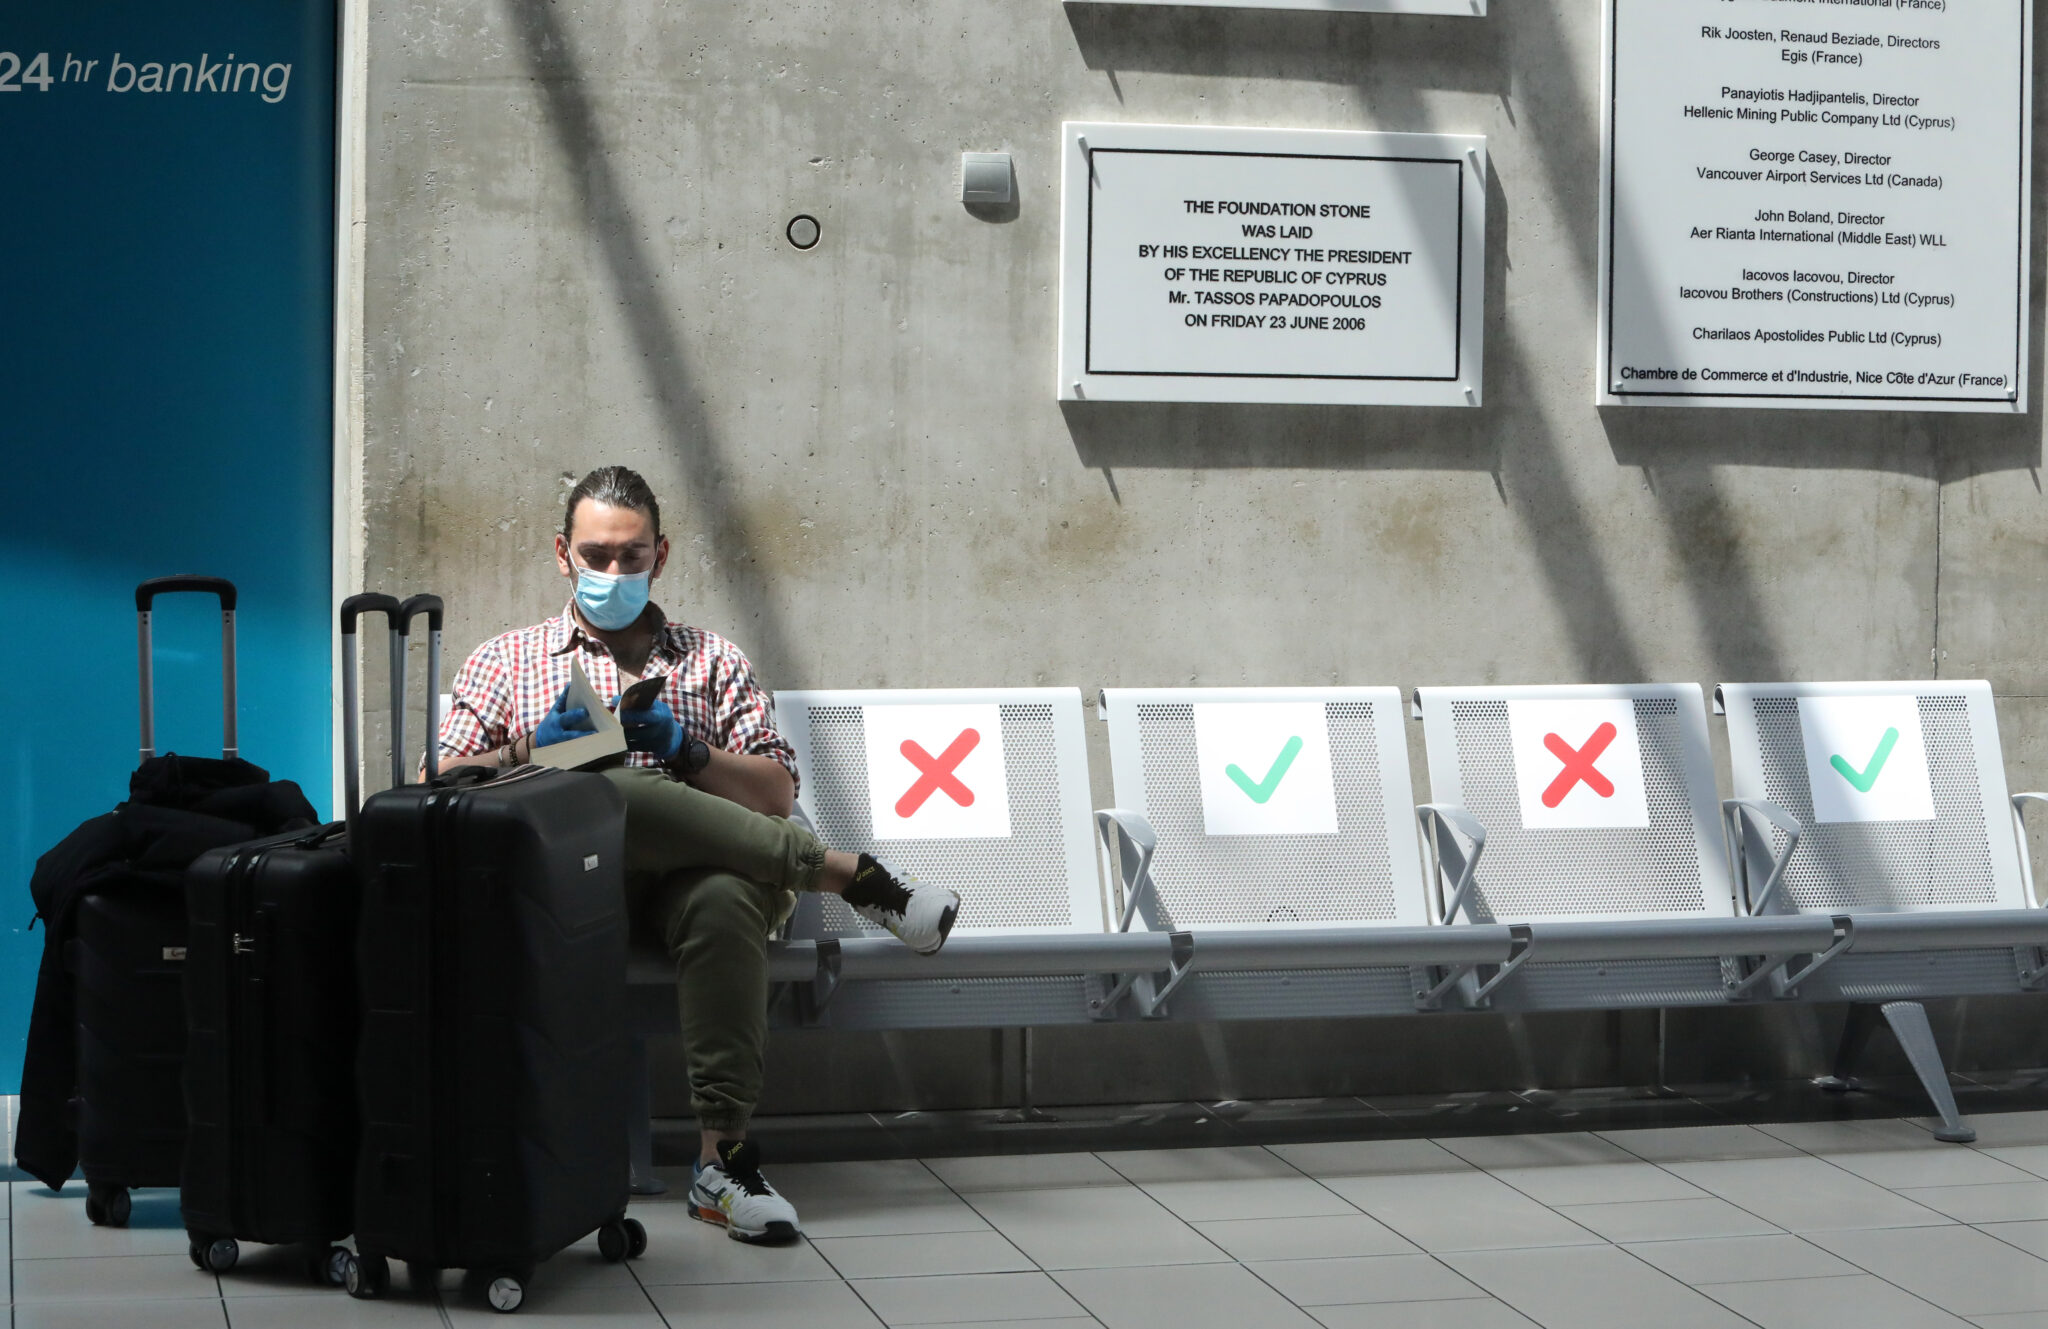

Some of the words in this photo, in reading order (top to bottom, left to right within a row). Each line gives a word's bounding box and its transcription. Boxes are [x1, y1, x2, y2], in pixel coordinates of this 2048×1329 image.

[1896, 0, 1946, 13] (France)
[1702, 27, 1722, 38] Rik
[1725, 28, 1776, 43] Joosten,
[1781, 30, 1828, 44] Renaud
[1832, 32, 1883, 48] Beziade,
[1888, 35, 1940, 49] Directors
[1782, 49, 1808, 64] Egis
[1812, 50, 1862, 67] (France)
[0, 52, 54, 91] 24
[61, 53, 98, 82] hr
[107, 53, 292, 103] banking
[1722, 86, 1784, 103] Panayiotis
[1788, 90, 1868, 106] Hadjipantelis,
[1873, 93, 1919, 106] Director
[1684, 106, 1733, 119] Hellenic
[1736, 108, 1777, 124] Mining
[1781, 109, 1818, 122] Public
[1822, 111, 1879, 128] Company
[1882, 114, 1900, 126] Ltd
[1904, 115, 1955, 131] (Cyprus)
[1750, 148, 1794, 164] George
[1798, 150, 1840, 166] Casey,
[1844, 152, 1891, 166] Director
[1696, 167, 1763, 181] Vancouver
[1766, 170, 1806, 184] Airport
[1810, 171, 1861, 184] Services
[1865, 173, 1883, 185] Ltd
[1888, 174, 1942, 190] (Canada)
[1184, 200, 1214, 214] THE
[1218, 201, 1316, 216] FOUNDATION
[1320, 204, 1370, 218] STONE
[1754, 209, 1784, 222] John
[1788, 210, 1833, 225] Boland,
[1838, 212, 1885, 225] Director
[1242, 224, 1276, 238] WAS
[1280, 226, 1313, 239] LAID
[1690, 226, 1712, 239] Aer
[1716, 227, 1755, 240] Rianta
[1760, 228, 1834, 242] International
[1838, 231, 1881, 245] (Middle
[1886, 233, 1916, 248] East)
[1920, 234, 1946, 246] WLL
[1139, 244, 1160, 258] BY
[1163, 245, 1188, 258] HIS
[1192, 246, 1291, 261] EXCELLENCY
[1294, 248, 1324, 262] THE
[1328, 250, 1412, 264] PRESIDENT
[1164, 268, 1186, 281] OF
[1189, 268, 1220, 282] THE
[1224, 269, 1298, 284] REPUBLIC
[1301, 271, 1322, 284] OF
[1326, 272, 1387, 286] CYPRUS
[1743, 268, 1789, 282] Iacovos
[1794, 270, 1843, 284] Iacovou,
[1848, 272, 1895, 284] Director
[1169, 290, 1190, 304] Mr.
[1194, 291, 1255, 306] TASSOS
[1259, 293, 1381, 308] PAPADOPOULOS
[1680, 286, 1728, 300] Iacovou
[1732, 288, 1783, 300] Brothers
[1787, 289, 1878, 306] (Constructions)
[1882, 292, 1900, 304] Ltd
[1904, 292, 1954, 308] (Cyprus)
[1185, 314, 1207, 327] ON
[1212, 314, 1266, 328] FRIDAY
[1270, 316, 1286, 328] 23
[1290, 316, 1329, 330] JUNE
[1332, 317, 1366, 330] 2006
[1693, 327, 1751, 340] Charilaos
[1754, 329, 1824, 343] Apostolides
[1828, 330, 1865, 343] Public
[1868, 332, 1887, 344] Ltd
[1891, 332, 1941, 348] (Cyprus)
[1622, 366, 1678, 380] Chambre
[1682, 368, 1697, 380] de
[1701, 368, 1768, 382] Commerce
[1772, 370, 1784, 382] et
[1786, 370, 1852, 384] d'Industrie,
[1856, 371, 1883, 384] Nice
[1886, 372, 1914, 384] Côte
[1918, 373, 1955, 385] d'Azur
[1958, 373, 2008, 389] (France)
